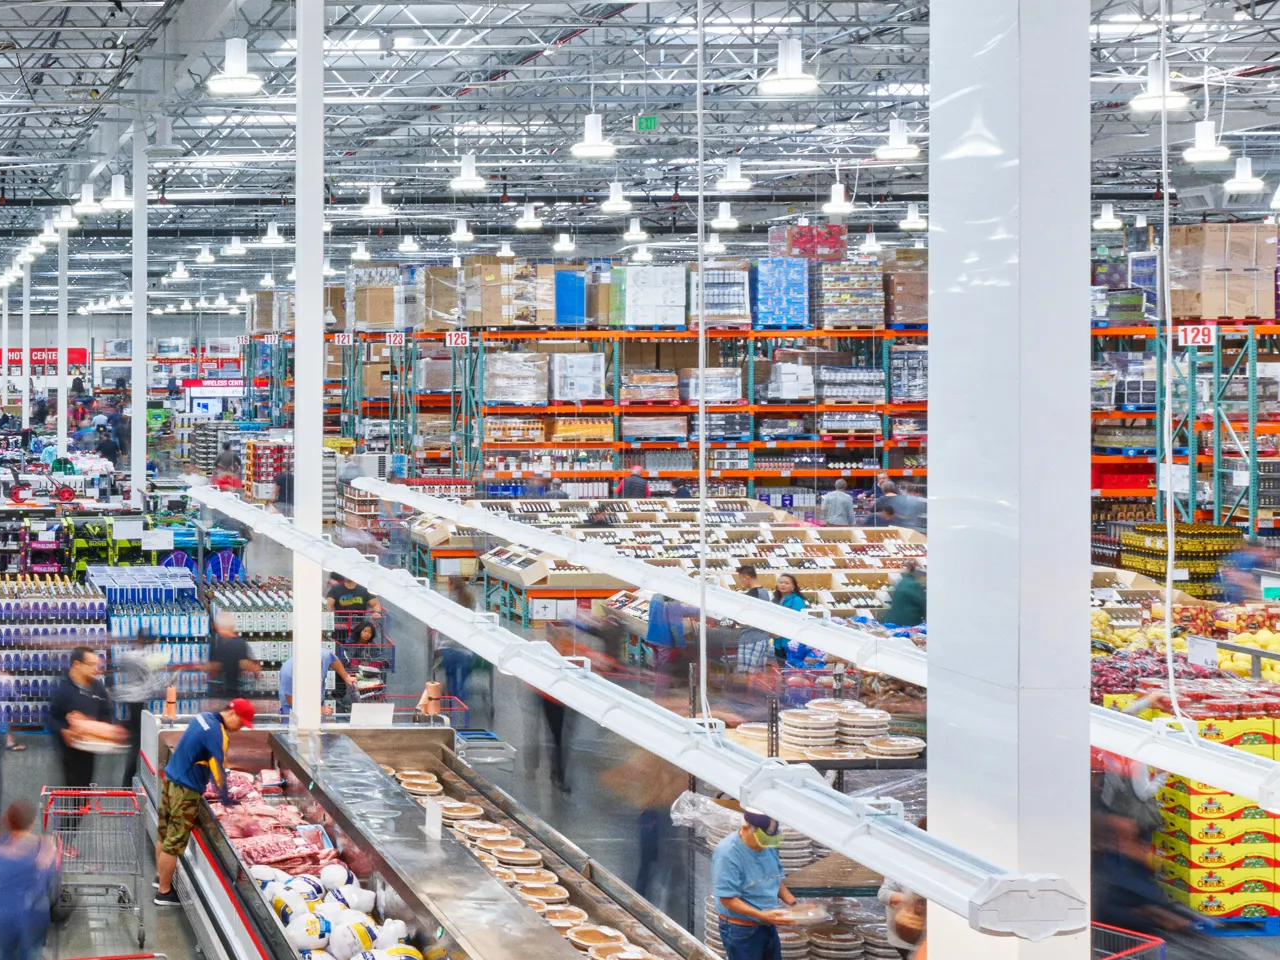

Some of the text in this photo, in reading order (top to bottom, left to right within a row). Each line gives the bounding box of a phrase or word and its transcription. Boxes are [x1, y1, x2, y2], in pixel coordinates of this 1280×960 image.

[264, 335, 277, 344] 117
[336, 334, 350, 344] 121
[388, 334, 403, 345] 123
[448, 333, 467, 345] 125
[1181, 327, 1211, 344] 129
[32, 352, 58, 360] CENTE
[202, 379, 227, 387] WIRELESS
[1197, 806, 1225, 814] CHERUBS
[1198, 831, 1226, 839] CHERUBS
[1198, 856, 1226, 864] CHERUBS
[1197, 880, 1225, 888] CHERUBS
[1197, 904, 1225, 912] CHERUBS
